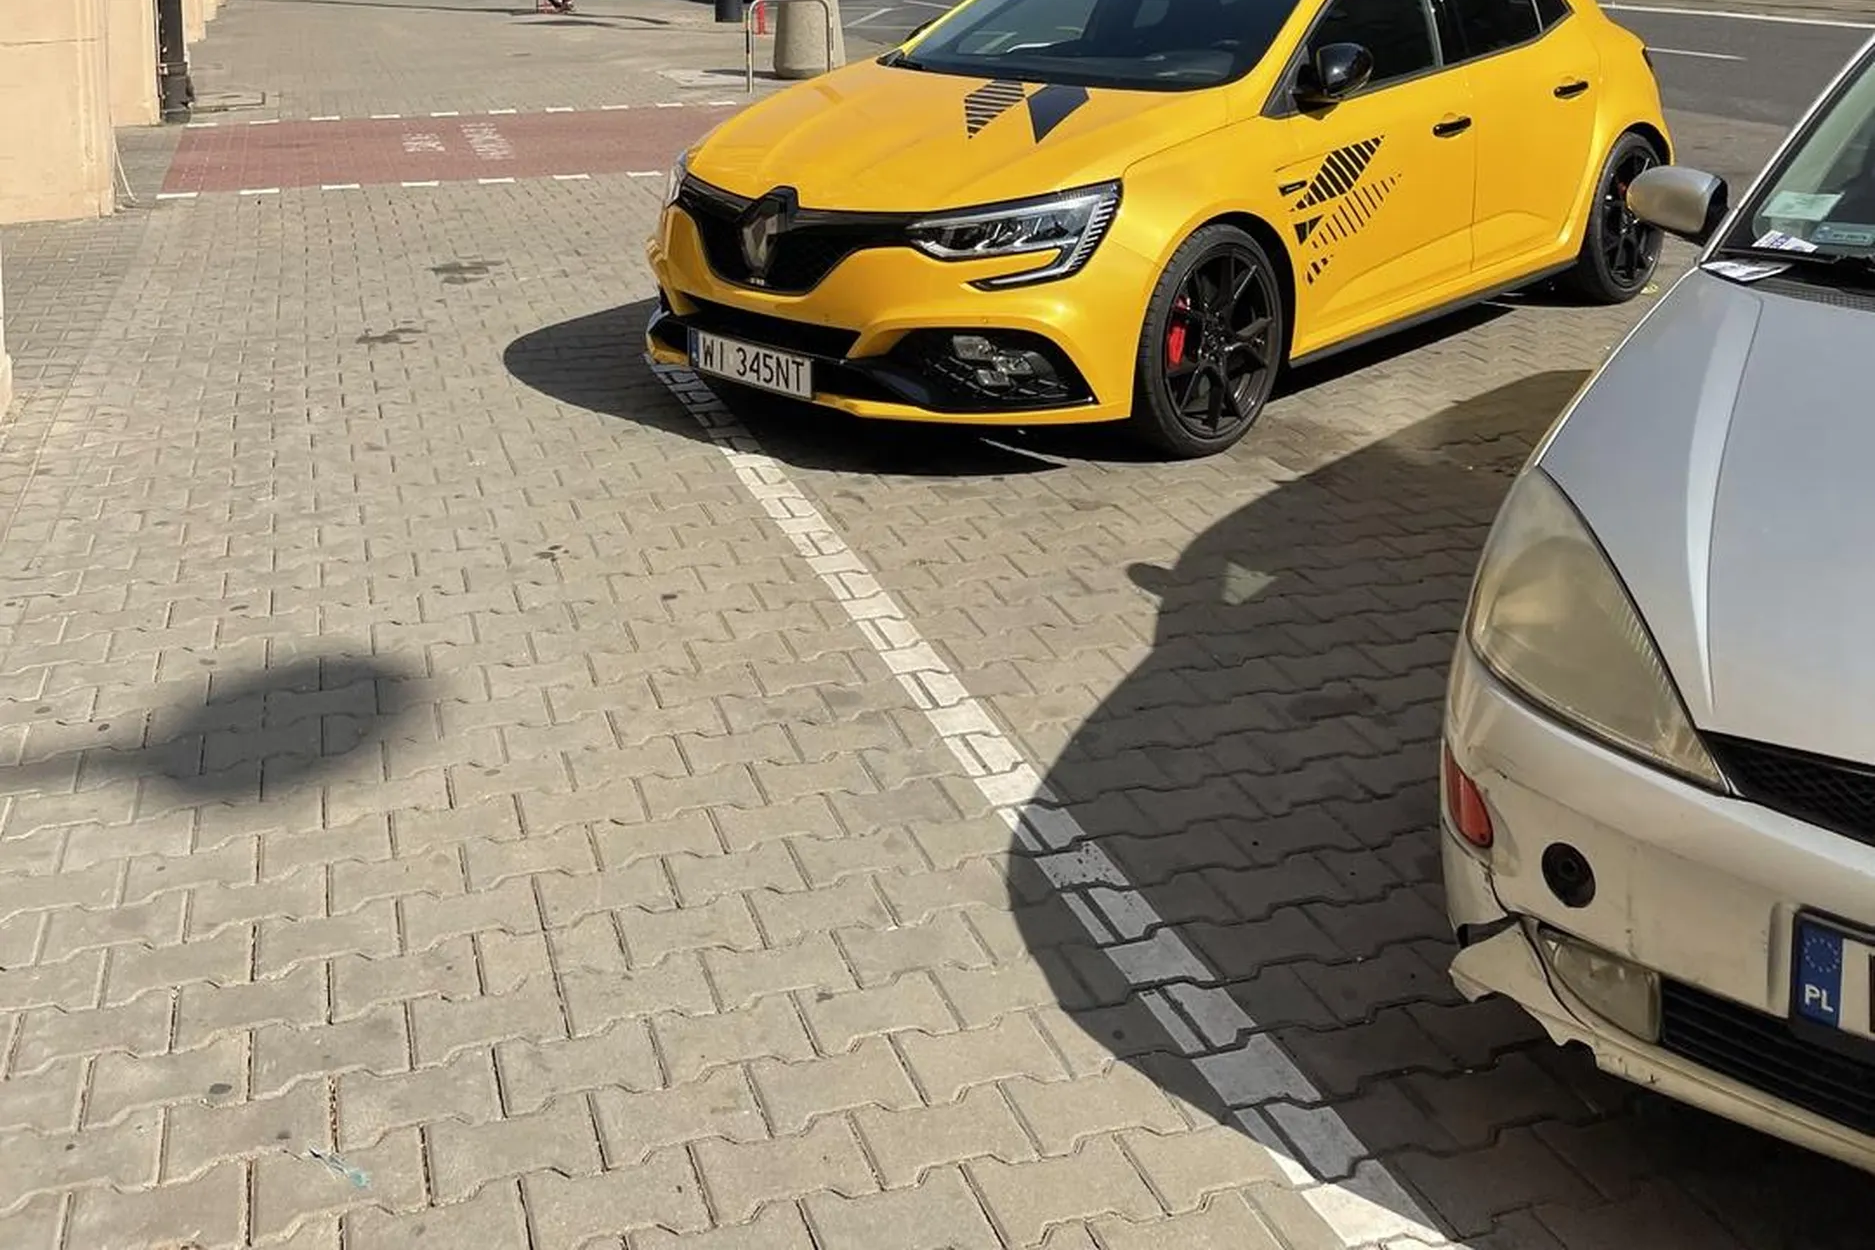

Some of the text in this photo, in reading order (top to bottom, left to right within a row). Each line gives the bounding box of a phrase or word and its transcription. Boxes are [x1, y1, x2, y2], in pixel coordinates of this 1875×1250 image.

[702, 336, 805, 392] WI 345NT
[1804, 983, 1834, 1013] PL
